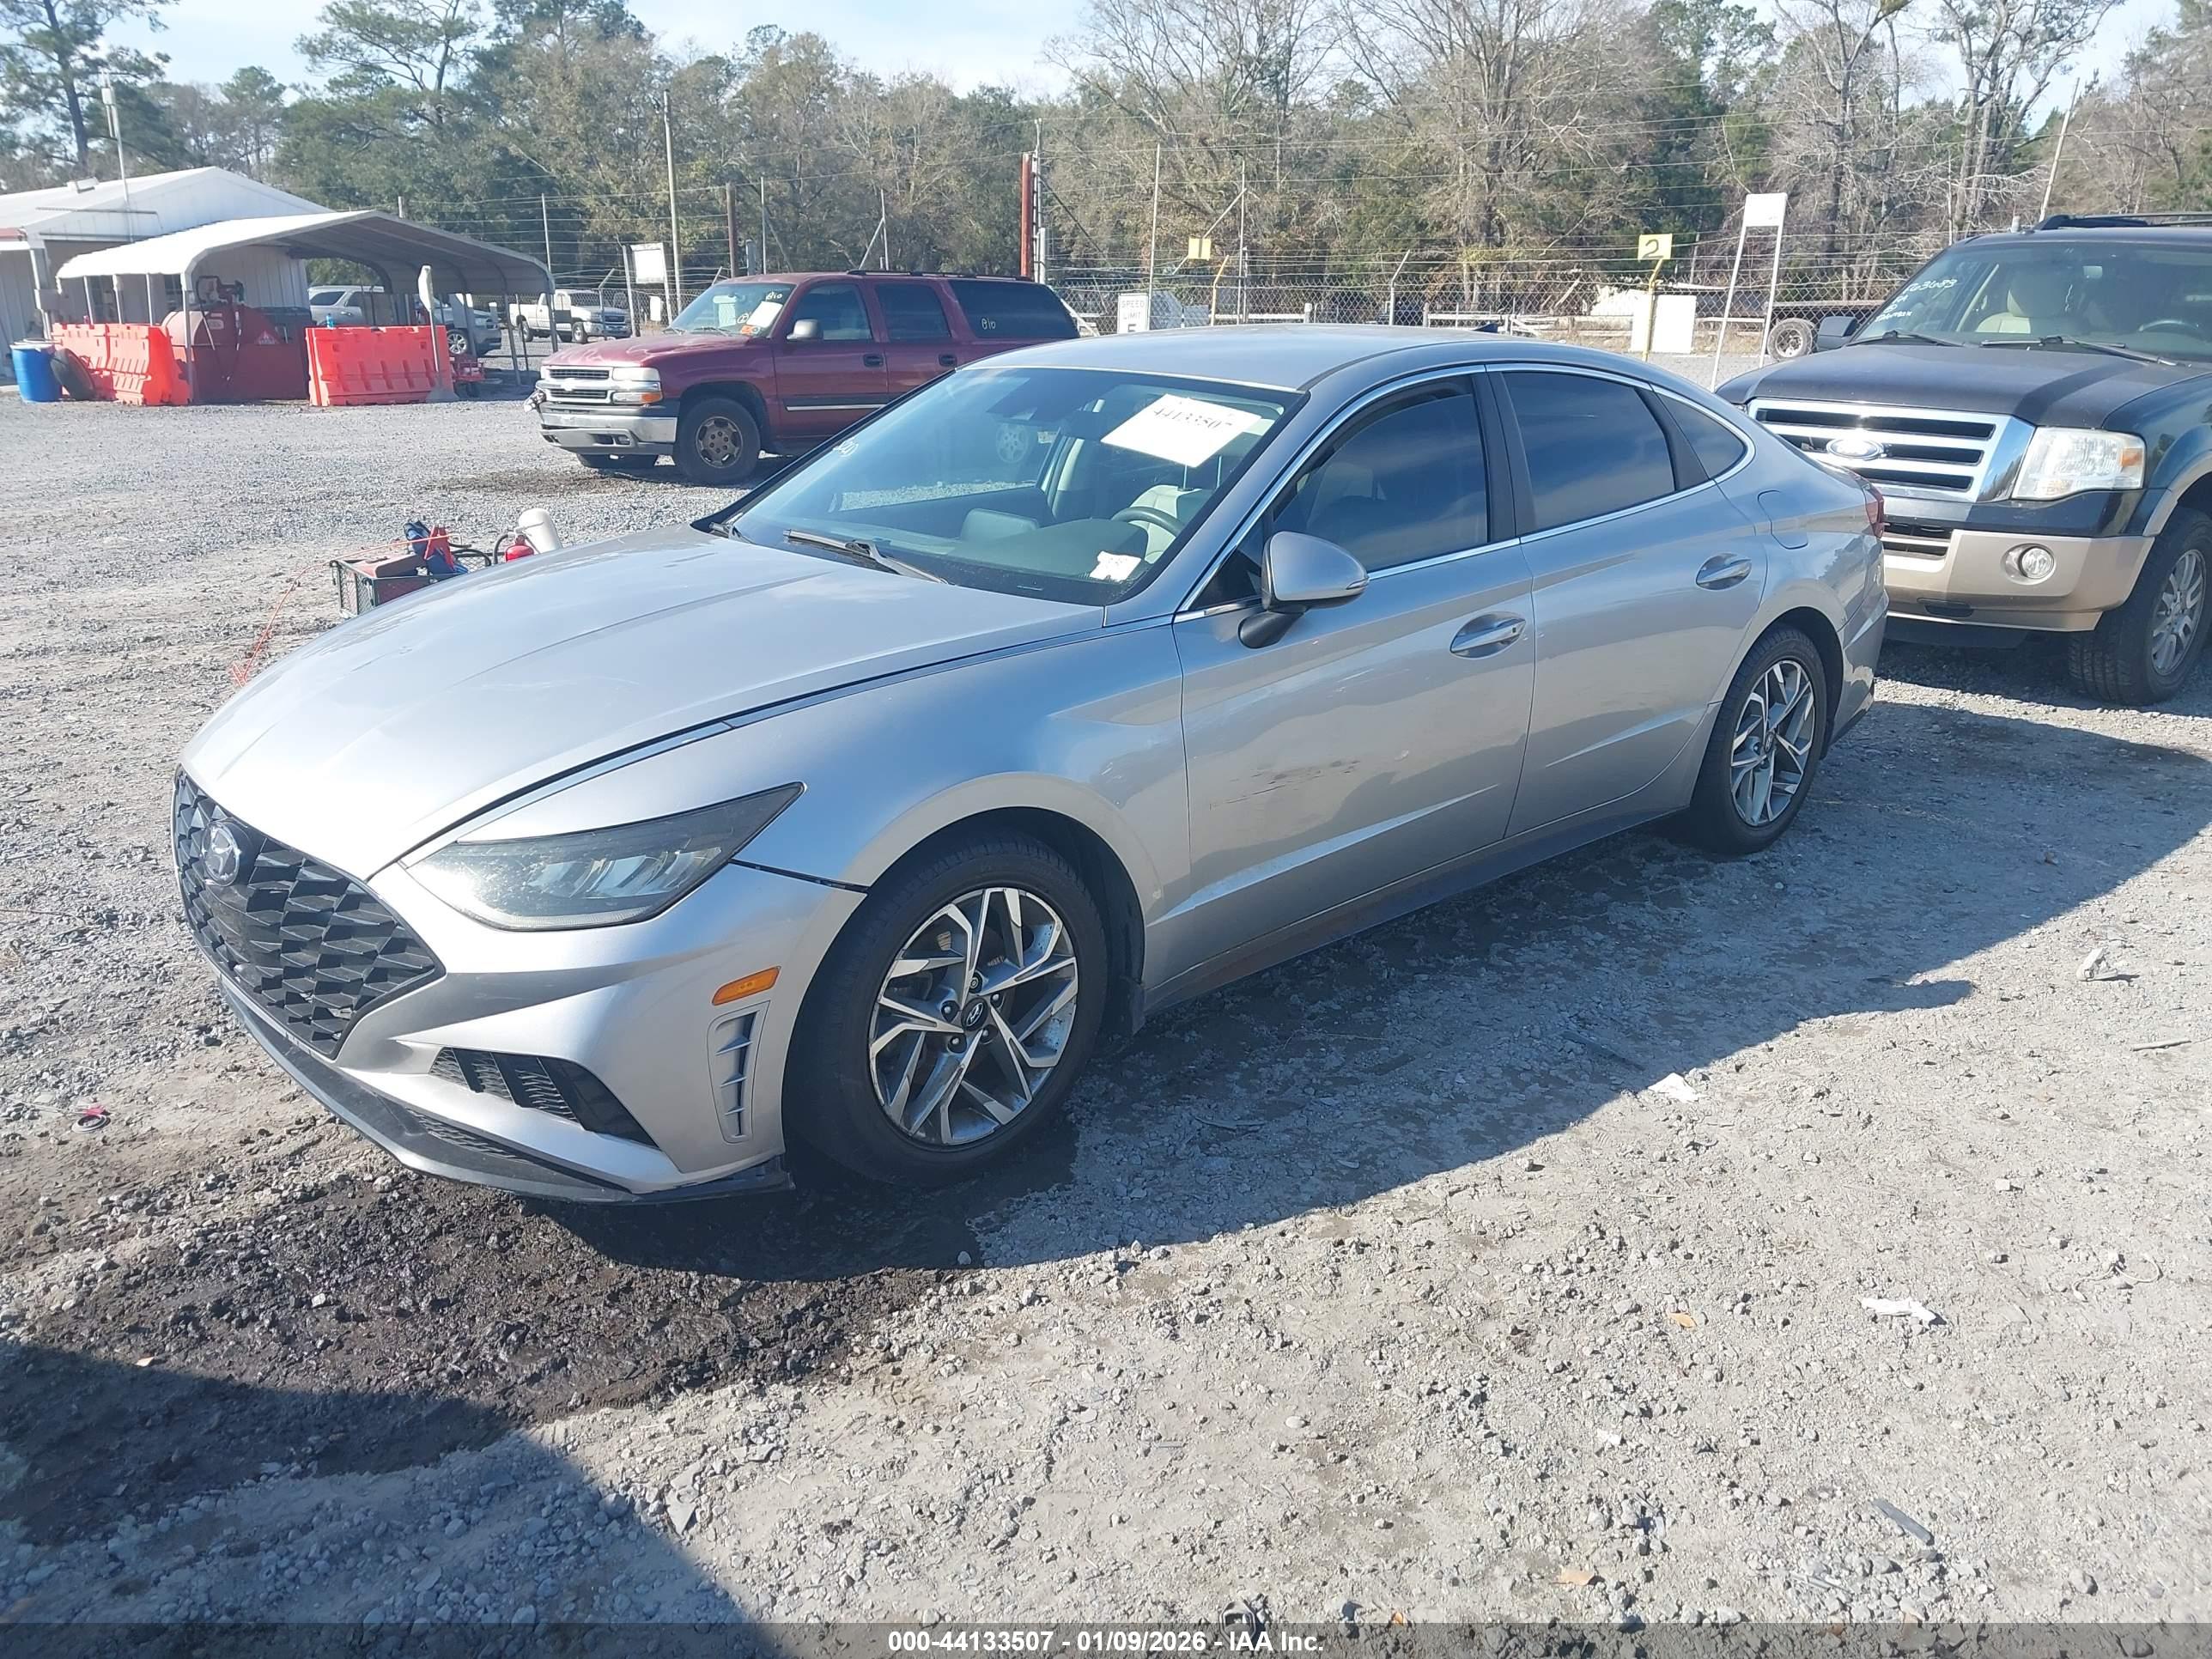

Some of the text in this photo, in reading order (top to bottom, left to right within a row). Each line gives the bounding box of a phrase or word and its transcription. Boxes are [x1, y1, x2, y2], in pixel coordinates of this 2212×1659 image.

[1642, 239, 1664, 258] 2
[1121, 300, 1145, 308] SPEED
[1122, 311, 1141, 320] LIMIT
